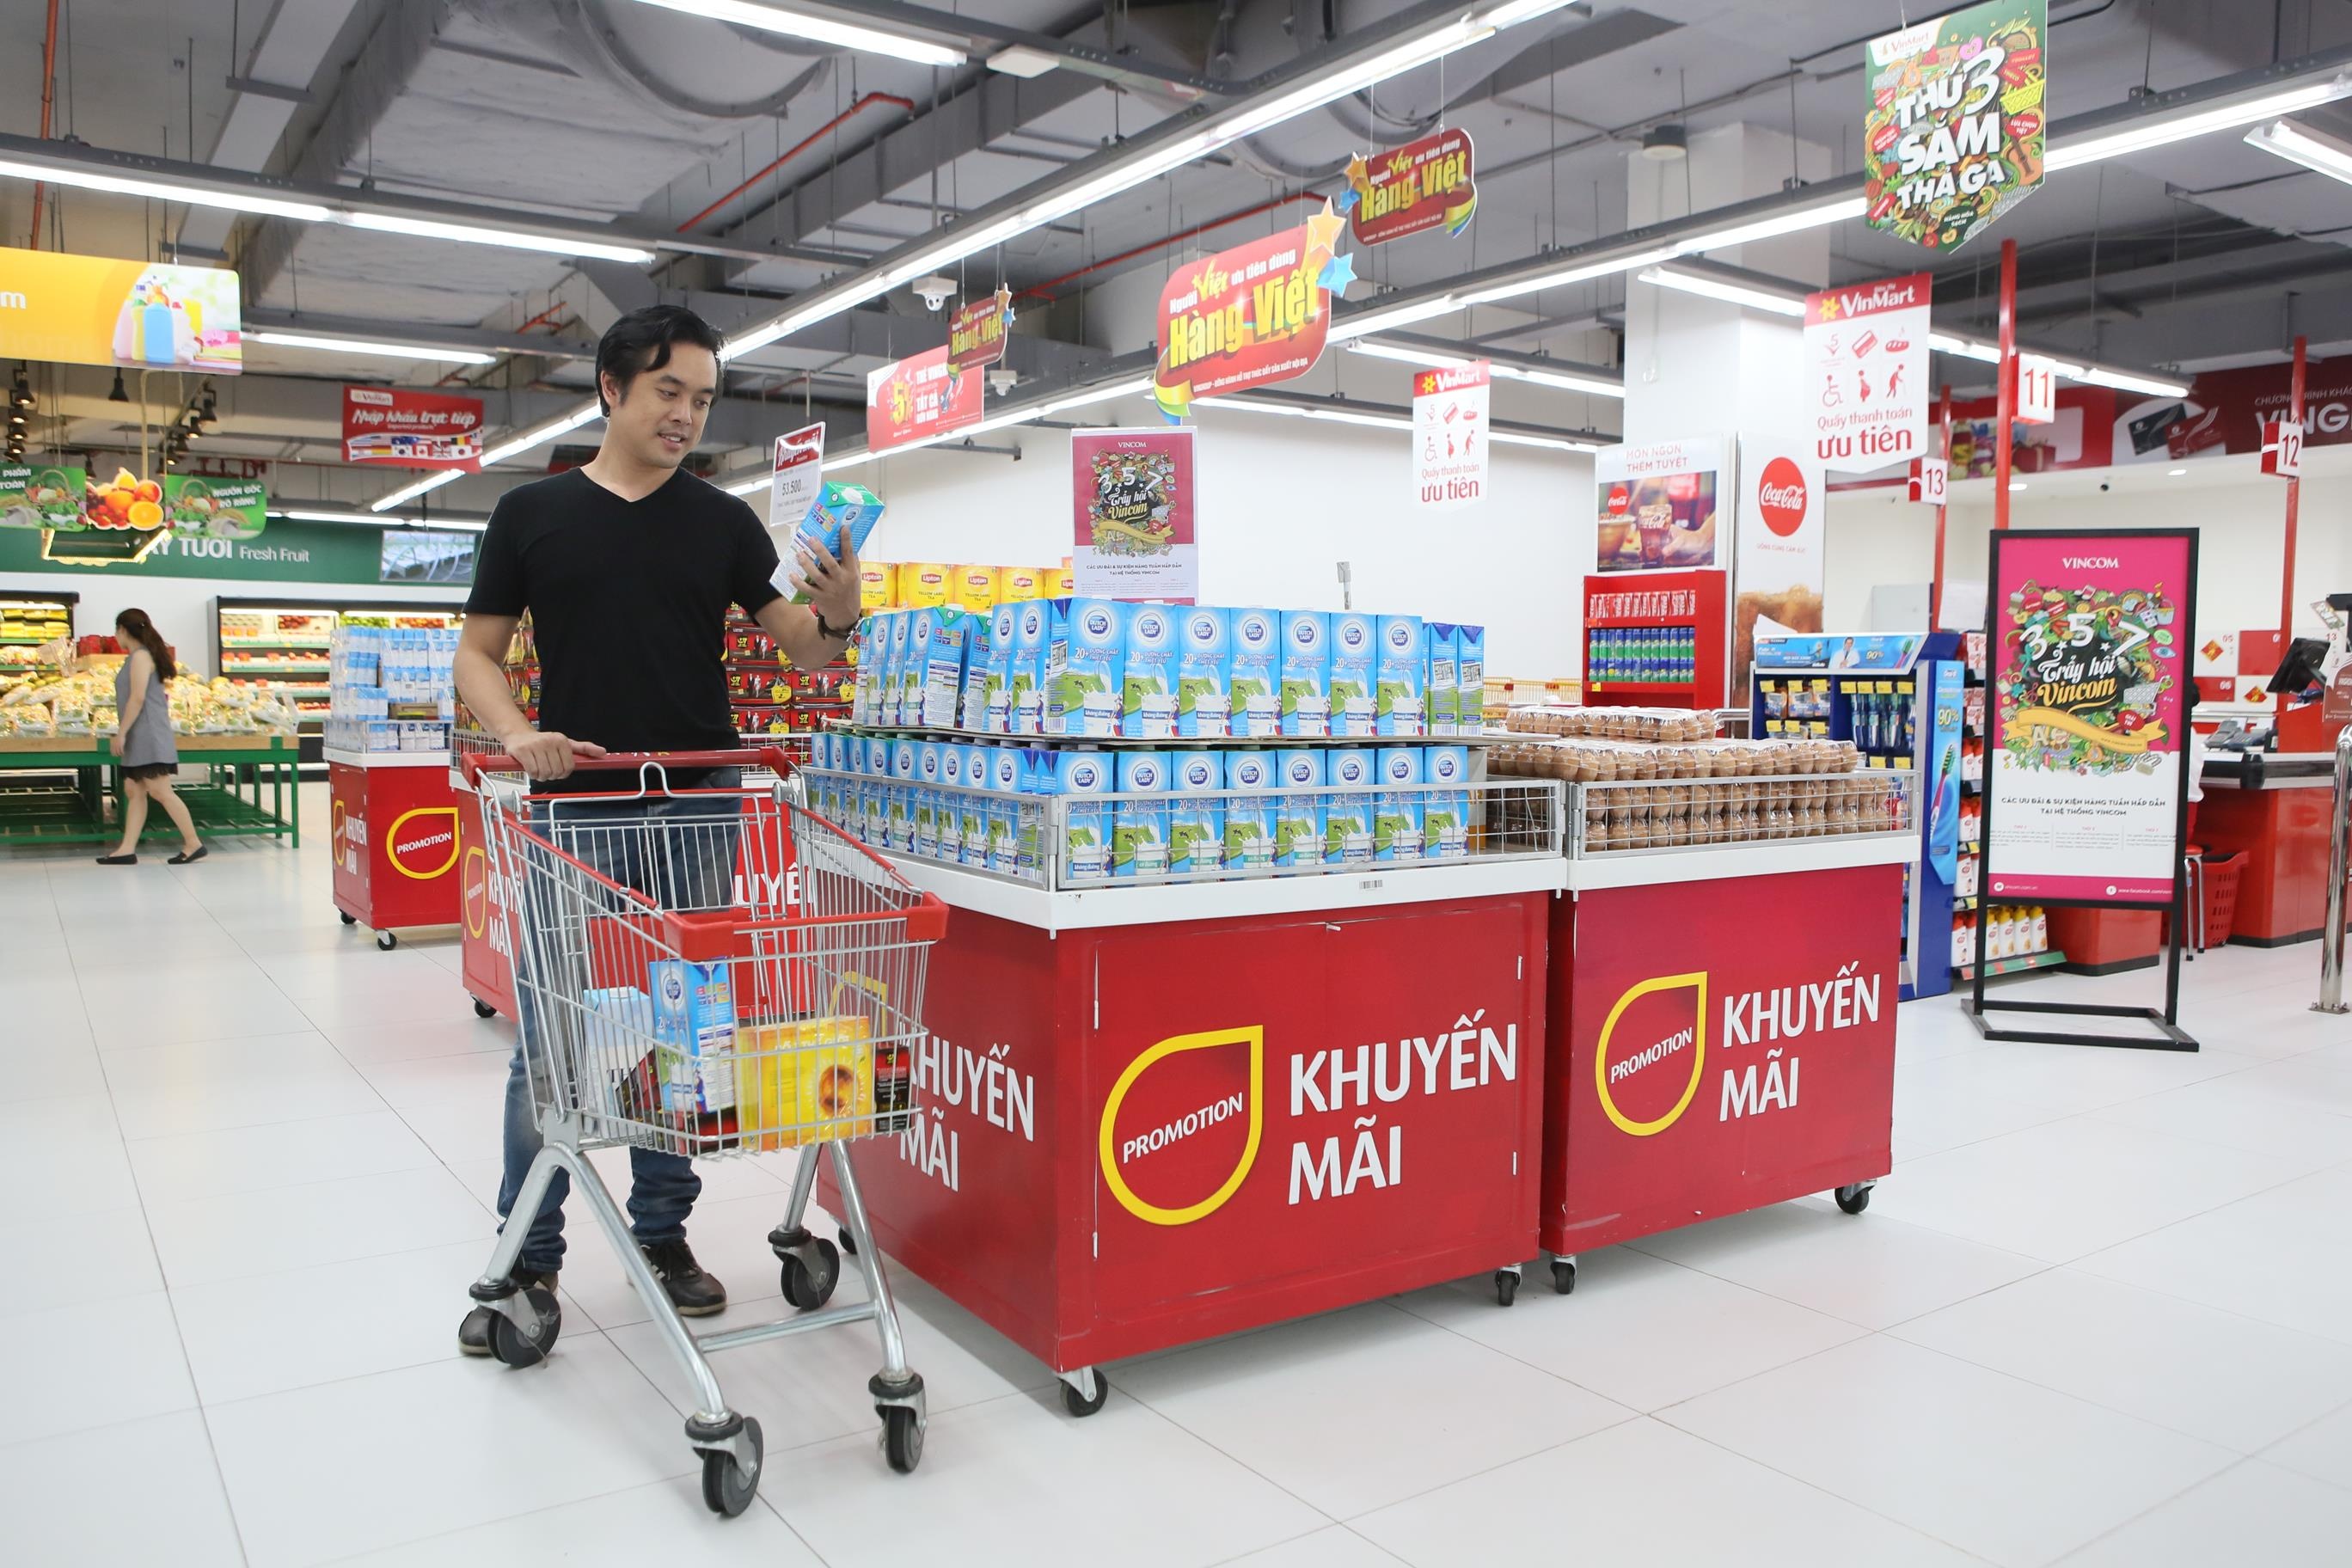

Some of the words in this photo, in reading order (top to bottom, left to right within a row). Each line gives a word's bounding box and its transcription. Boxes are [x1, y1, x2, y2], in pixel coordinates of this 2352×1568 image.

[1963, 46, 2006, 114] 3
[1897, 112, 2000, 175] SẮM
[1361, 176, 1415, 224] Hàng
[1421, 150, 1467, 198] Việt
[1959, 160, 2006, 194] GA
[1170, 289, 1197, 315] Người
[1191, 259, 1229, 301] Việt
[1246, 260, 1267, 282] tiên
[1269, 248, 1296, 272] dùng
[1169, 303, 1245, 369] Hàng
[1253, 267, 1320, 337] Việt
[1841, 285, 1915, 317] VinMart
[1436, 371, 1481, 392] VinMart
[2024, 368, 2049, 409] 11
[1817, 413, 1847, 430] Quầy
[1849, 409, 1883, 425] thanh
[1885, 407, 1913, 421] toán
[1817, 435, 1852, 459] ưu
[1859, 425, 1912, 455] tiên
[2282, 433, 2300, 467] 12
[1098, 474, 1112, 494] 3
[1121, 467, 1136, 486] 5
[1146, 471, 1163, 491] 7
[1441, 464, 1461, 477] thanh
[1463, 463, 1479, 474] toán
[1926, 468, 1945, 496] 13
[782, 479, 802, 496] 53.500
[1422, 484, 1442, 502] ưu
[1447, 476, 1479, 500] tiên
[1761, 481, 1805, 510] Coca-Cola
[1107, 502, 1148, 519] Vincom
[240, 545, 277, 561] Fresh
[280, 548, 309, 563] Fruit
[2062, 557, 2119, 569] VINCOM
[2019, 624, 2048, 661] 3
[2067, 613, 2098, 647] 5
[2113, 620, 2151, 658] 7
[2037, 677, 2118, 707] Vincom
[396, 831, 452, 854] PROMOTION
[1723, 960, 1880, 1049] KHUYẾN
[1290, 1008, 1516, 1117] KHUYẾN
[1610, 1026, 1693, 1084] PROMOTION
[1719, 1047, 1799, 1122] MÃI
[1123, 1092, 1243, 1164] PROMOTION
[900, 1106, 959, 1193] MÃI
[1288, 1114, 1402, 1205] MÃI
